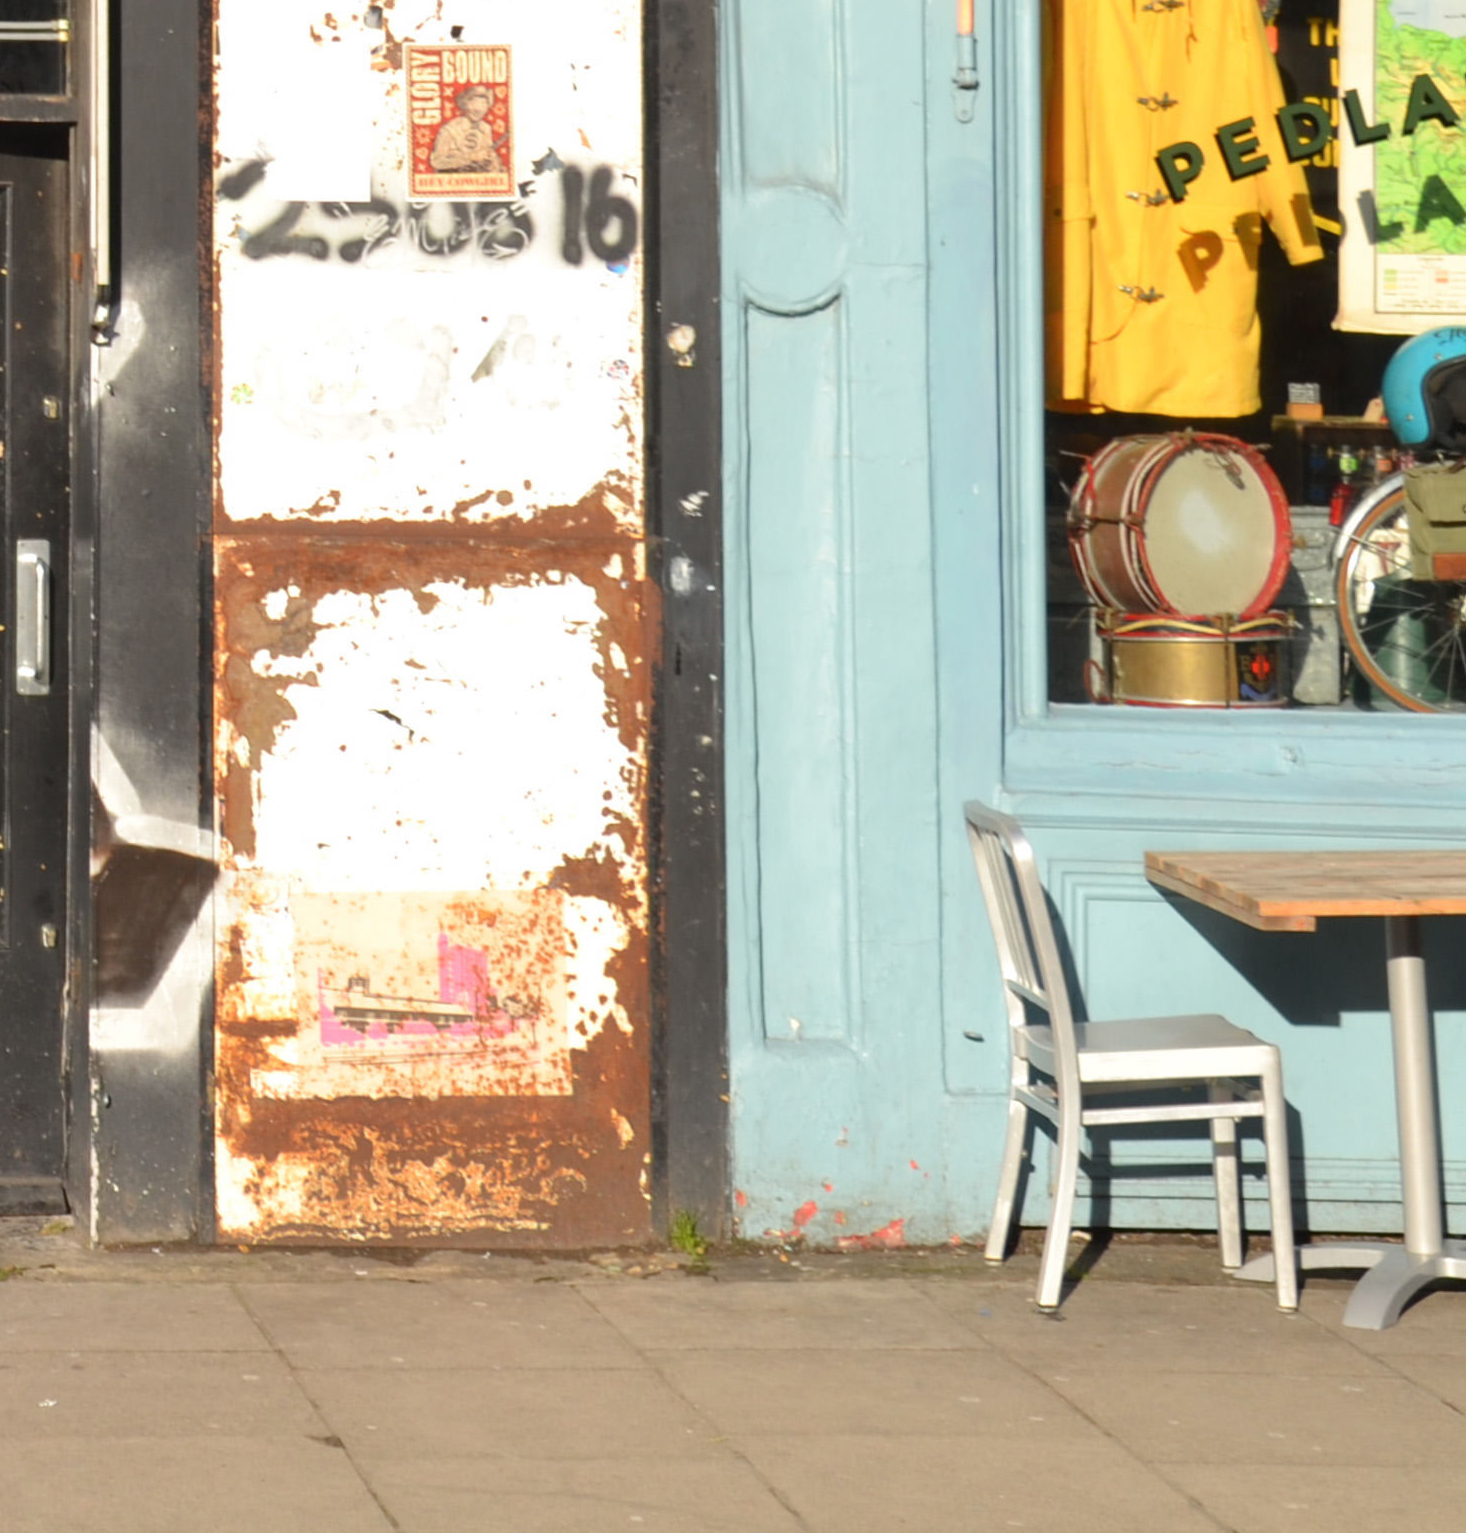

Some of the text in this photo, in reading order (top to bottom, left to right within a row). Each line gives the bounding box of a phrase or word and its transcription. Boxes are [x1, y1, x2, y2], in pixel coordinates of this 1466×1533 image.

[411, 51, 442, 126] GLORY
[441, 49, 508, 84] BOUND
[1154, 71, 1466, 205] PEDLA
